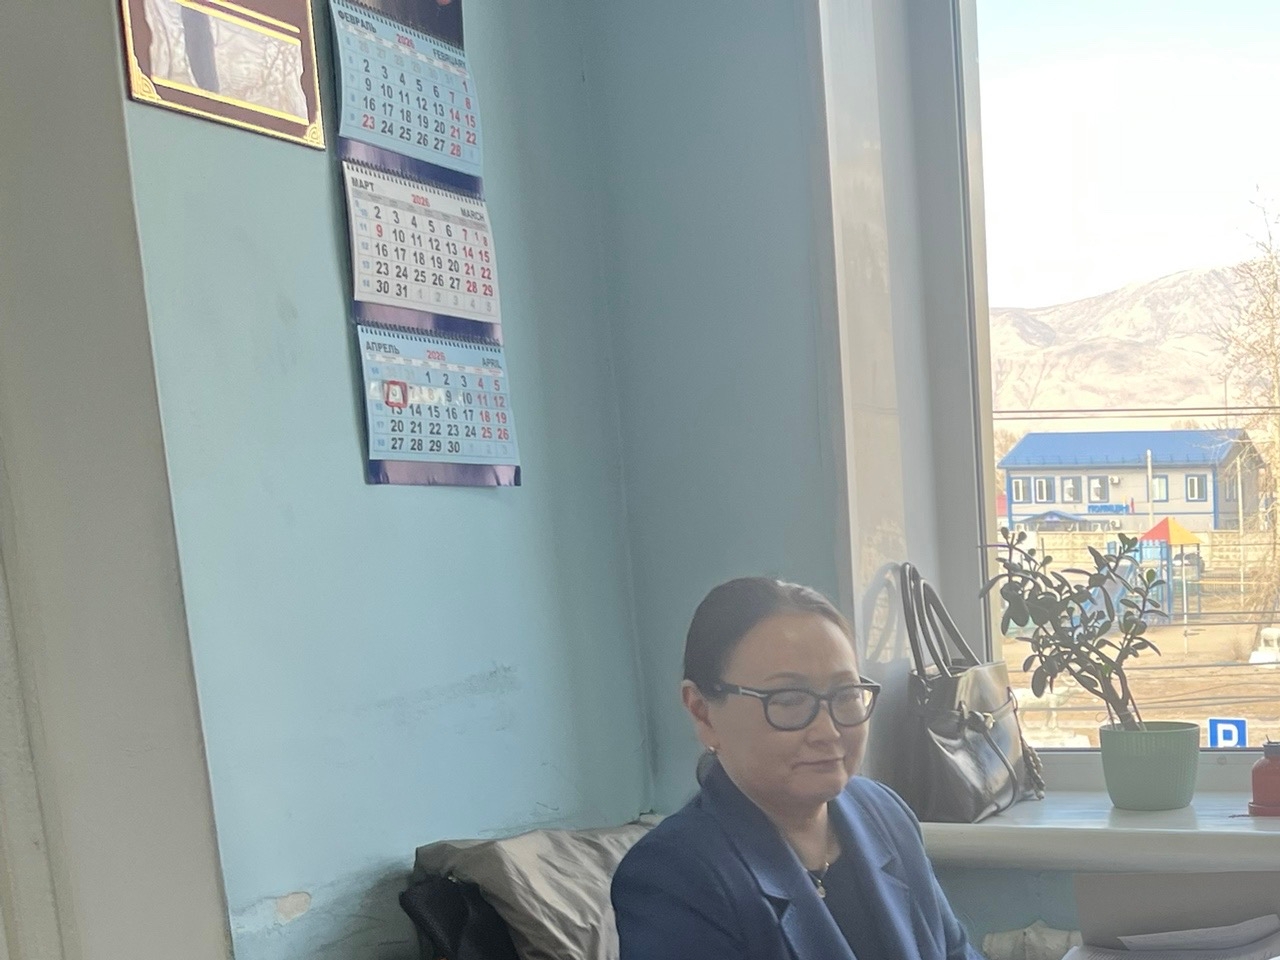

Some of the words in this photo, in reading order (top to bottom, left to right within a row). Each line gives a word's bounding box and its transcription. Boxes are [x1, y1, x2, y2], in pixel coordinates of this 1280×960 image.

[338, 11, 377, 33] ФЕВРАЛЬ
[396, 34, 415, 49] 2026
[364, 59, 370, 73] 2
[382, 66, 388, 79] 3
[400, 73, 405, 85] 4
[416, 79, 422, 92] 5
[434, 86, 439, 98] 6
[449, 91, 455, 103] 7
[465, 97, 471, 109] 8
[463, 81, 468, 92] 1
[365, 78, 371, 91] 9
[381, 84, 392, 99] 10
[399, 90, 409, 105] 11
[416, 96, 428, 111] 12
[434, 102, 444, 116] 13
[450, 108, 460, 122] 14
[465, 115, 475, 128] 15
[363, 96, 375, 111] 16
[382, 102, 393, 117] 17
[400, 109, 411, 123] 18
[417, 114, 428, 129] 19
[434, 120, 445, 134] 20
[450, 126, 460, 139] 21
[466, 131, 476, 145] 22
[362, 114, 375, 129] 23
[381, 121, 393, 136] 24
[399, 127, 411, 141] 25
[417, 132, 428, 146] 26
[434, 138, 445, 152] 27
[450, 143, 461, 157] 28
[351, 177, 375, 192] МАРТ
[411, 194, 430, 207] 2026
[461, 208, 484, 221] MARCH
[374, 206, 381, 219] 2
[393, 211, 399, 224] 3
[412, 216, 417, 228] 4
[429, 221, 435, 233] 5
[446, 225, 452, 237] 6
[463, 229, 468, 241] 7
[483, 237, 487, 246] 8
[376, 224, 383, 238] 9
[393, 229, 405, 243] 10
[411, 234, 423, 248] 11
[429, 238, 440, 252] 12
[446, 242, 457, 256] 13
[463, 246, 474, 259] 14
[479, 250, 490, 263] 15
[376, 243, 388, 257] 16
[394, 248, 406, 261] 17
[413, 252, 425, 265] 18
[431, 256, 442, 269] 19
[448, 260, 459, 273] 20
[465, 264, 475, 275] 21
[481, 267, 491, 280] 22
[376, 261, 389, 276] 23
[395, 265, 408, 279] 24
[414, 269, 426, 283] 25
[432, 273, 444, 287] 26
[450, 277, 461, 290] 27
[466, 280, 477, 294] 28
[483, 284, 493, 297] 29
[376, 280, 389, 294] 30
[396, 283, 407, 297] 31
[418, 288, 422, 299] 1
[436, 292, 441, 303] 2
[454, 296, 458, 305] 3
[470, 299, 475, 308] 4
[487, 302, 491, 312] 5
[366, 341, 400, 355] АПРЕЛЬ
[426, 350, 445, 361] 2026
[482, 358, 502, 368] APRIL
[426, 371, 431, 383] 1
[443, 373, 450, 385] 2
[461, 376, 467, 387] 3
[478, 378, 484, 389] 4
[494, 380, 500, 391] 5
[446, 392, 452, 402] 9
[462, 392, 472, 404] 10
[477, 394, 488, 406] 11
[494, 396, 504, 407] 12
[409, 405, 422, 416] 14
[428, 406, 440, 418] 15
[446, 408, 457, 420] 16
[463, 410, 473, 421] 17
[480, 411, 490, 422] 18
[496, 412, 507, 424] 19
[391, 420, 404, 432] 20
[410, 421, 422, 434] 21
[429, 423, 441, 435] 22
[448, 424, 459, 436] 23
[465, 426, 476, 438] 24
[481, 427, 492, 439] 25
[498, 428, 509, 440] 26
[391, 438, 404, 450] 27
[410, 439, 423, 451] 28
[429, 440, 441, 452] 29
[448, 441, 460, 453] 30
[1217, 723, 1239, 748] P
